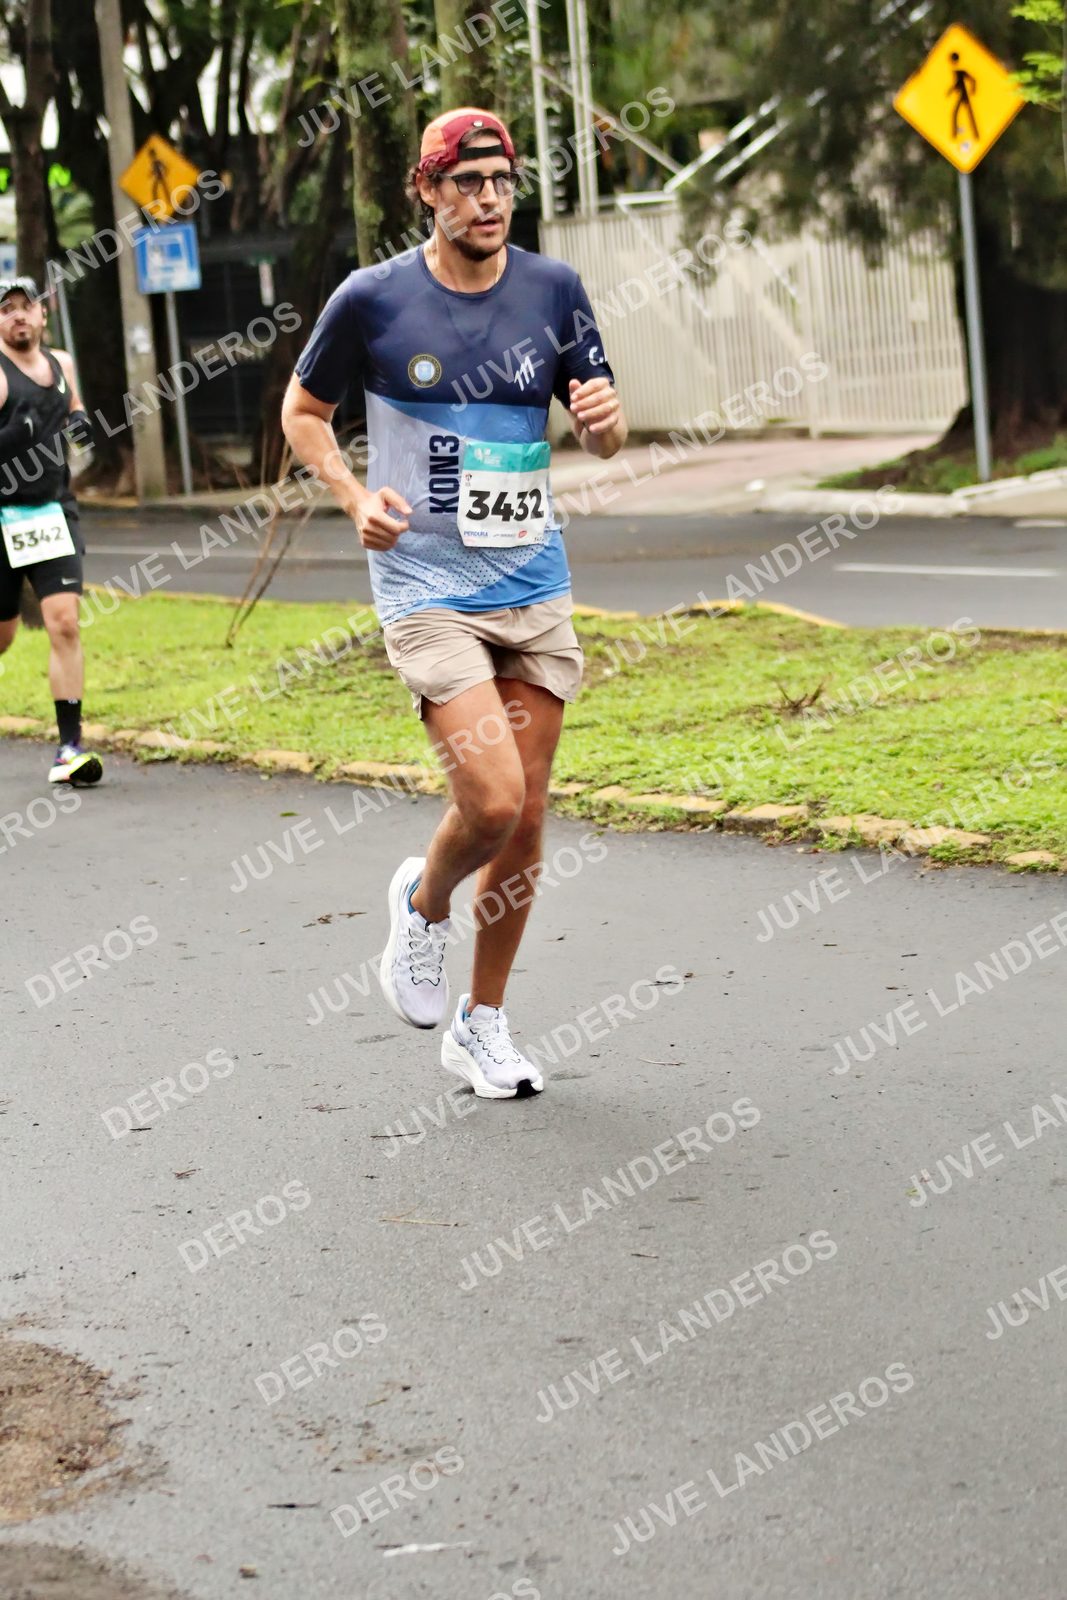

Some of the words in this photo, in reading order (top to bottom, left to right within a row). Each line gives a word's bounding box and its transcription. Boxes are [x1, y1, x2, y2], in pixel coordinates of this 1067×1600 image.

[429, 434, 460, 514] KON3
[465, 488, 545, 522] 3432
[11, 526, 64, 551] 5342
